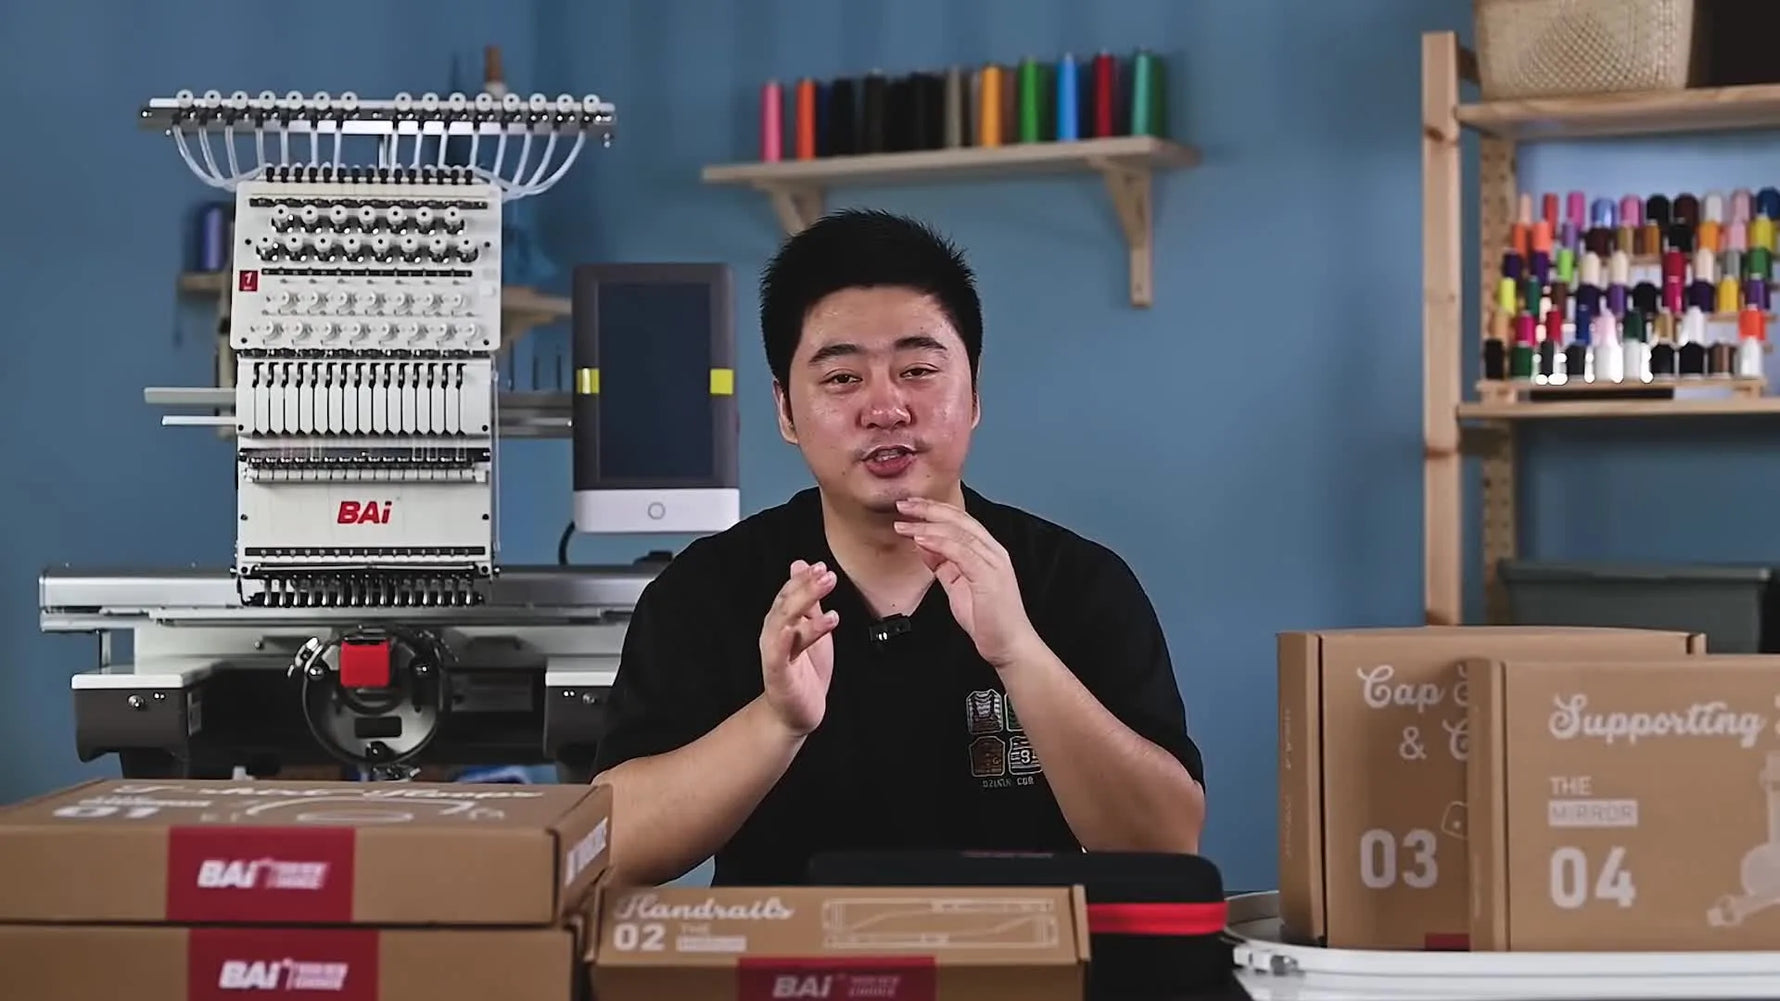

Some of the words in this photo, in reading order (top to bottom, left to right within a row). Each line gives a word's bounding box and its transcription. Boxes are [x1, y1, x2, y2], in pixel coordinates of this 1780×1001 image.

[337, 501, 392, 524] BAi
[1356, 664, 1445, 713] Cap
[1549, 694, 1767, 748] Supporting
[1550, 776, 1592, 795] THE
[1360, 829, 1438, 889] 03
[1550, 846, 1637, 909] 04
[614, 893, 796, 921] Handrails
[613, 922, 666, 951] 02
